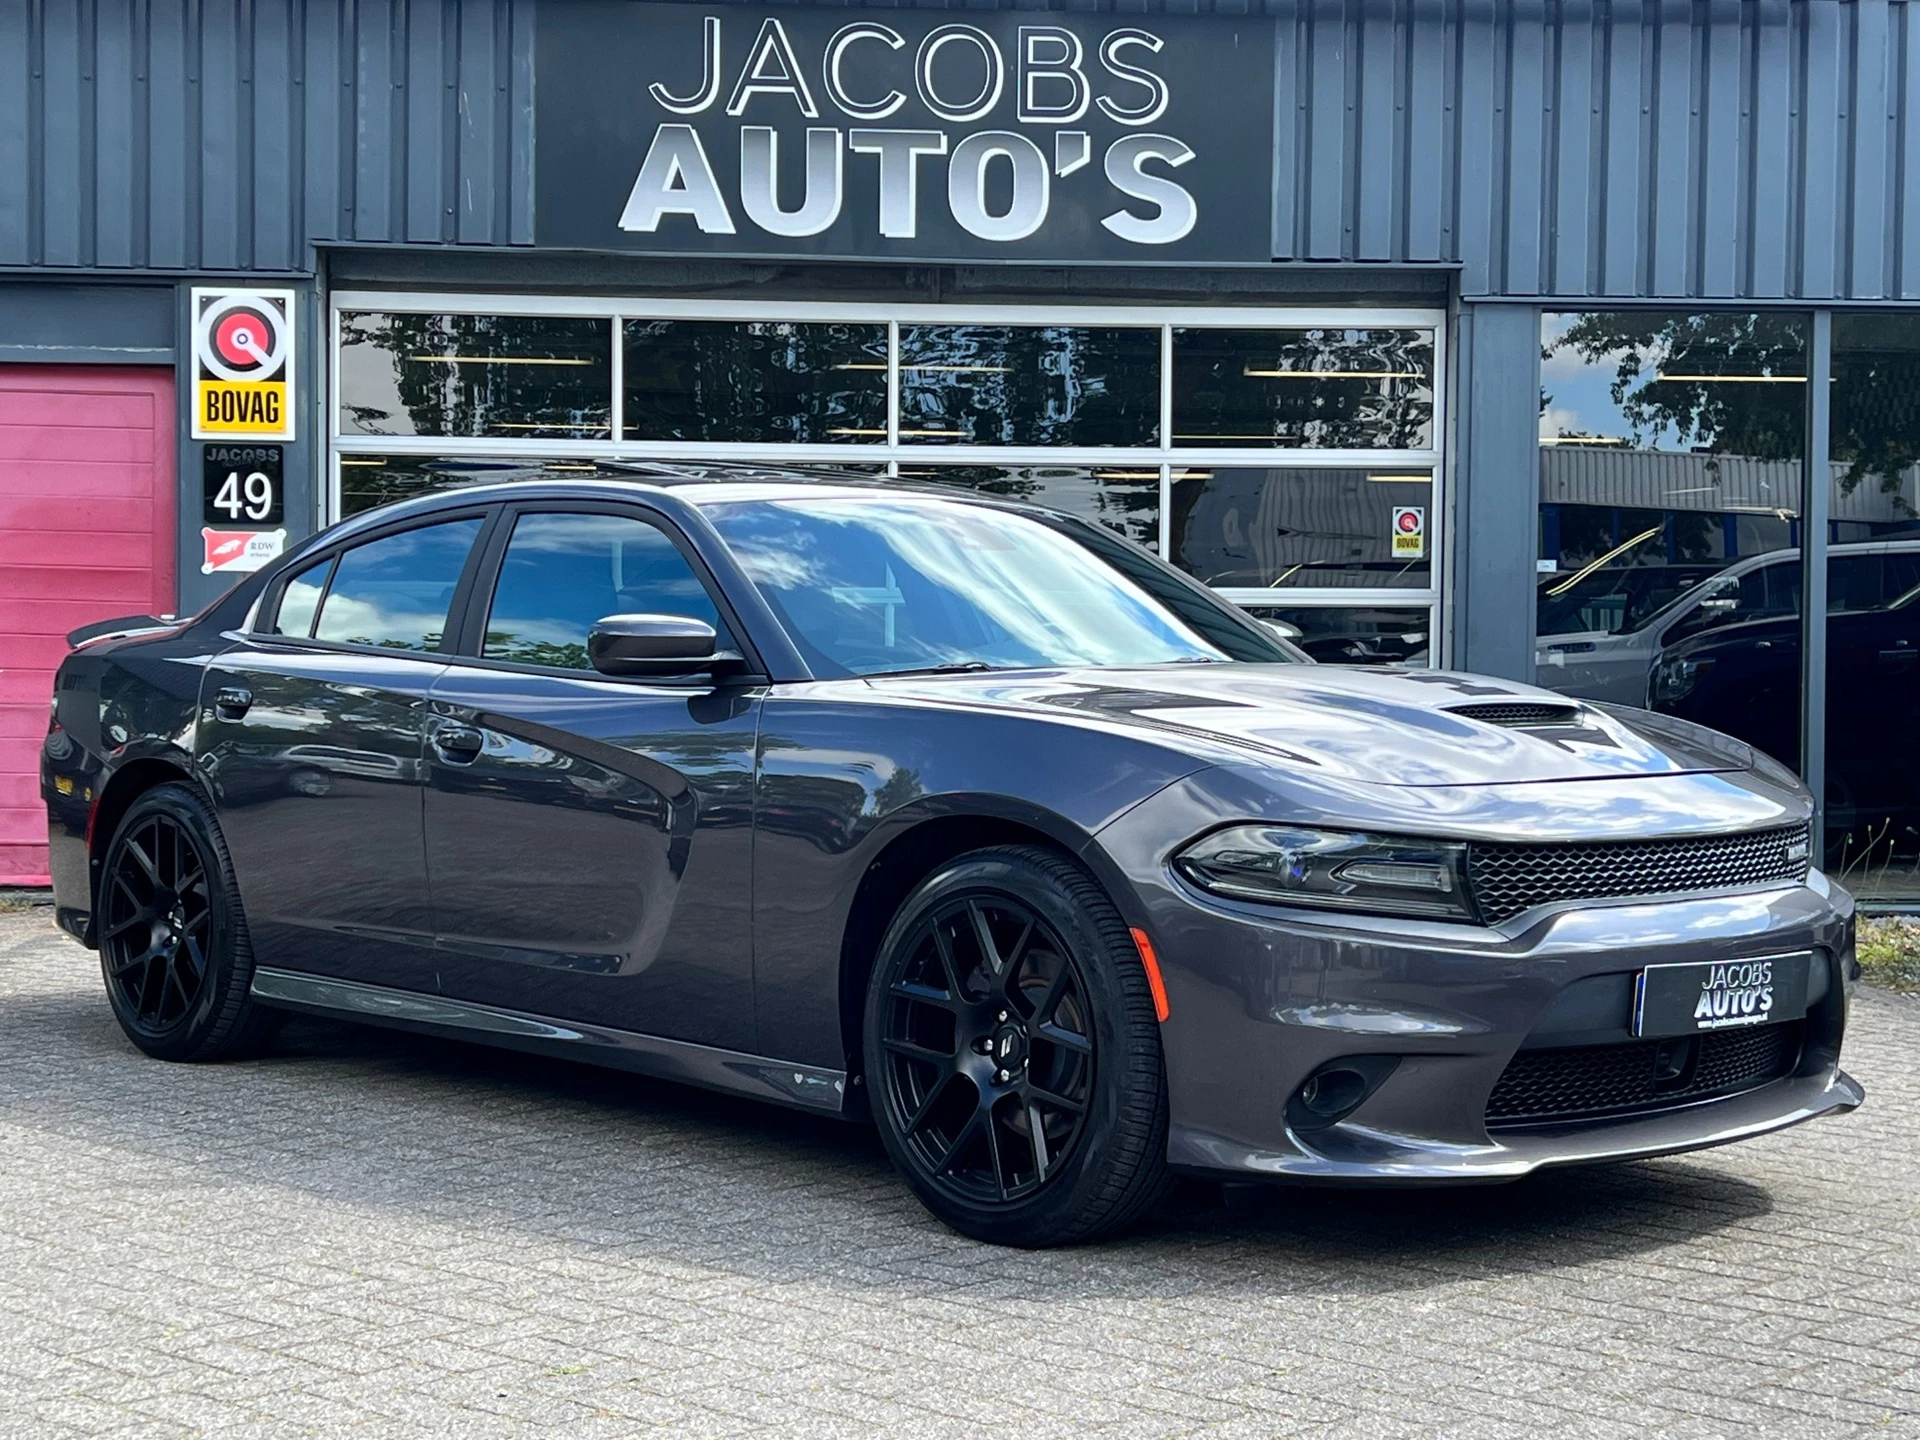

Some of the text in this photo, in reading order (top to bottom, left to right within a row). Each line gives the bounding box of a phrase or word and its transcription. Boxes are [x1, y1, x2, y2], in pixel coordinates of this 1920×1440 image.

[648, 16, 1168, 125] JACOBS
[617, 123, 1197, 244] AUTO'S
[206, 390, 279, 423] BOVAG
[206, 448, 280, 461] JACOBS
[213, 472, 272, 520] 49
[250, 542, 275, 550] RDW
[1701, 962, 1772, 990] JACOBS
[1694, 984, 1774, 1018] AUTO'S
